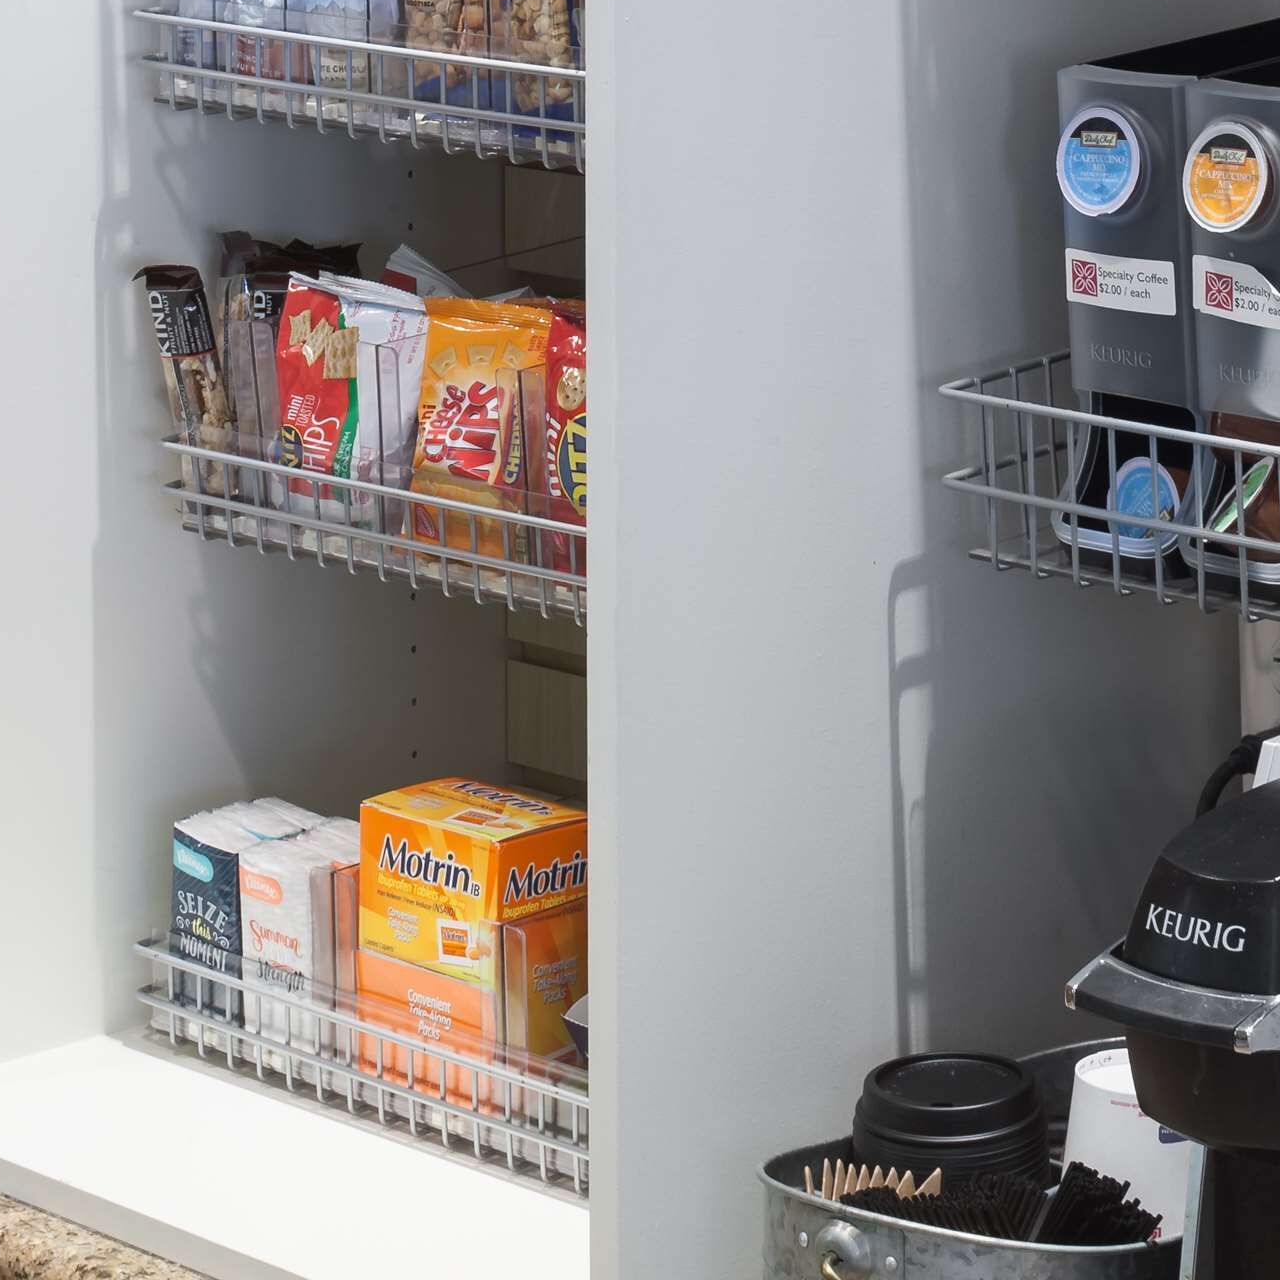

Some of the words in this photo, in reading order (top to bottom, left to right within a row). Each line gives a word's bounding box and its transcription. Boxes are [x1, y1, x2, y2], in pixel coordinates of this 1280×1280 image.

[1098, 267, 1134, 286] Specialty
[1136, 271, 1168, 285] Coffee
[1098, 282, 1121, 296] $2.00
[1130, 287, 1151, 299] each
[1234, 281, 1271, 302] Specialty
[162, 294, 171, 314] NUT
[1234, 297, 1260, 312] $2.00
[149, 291, 171, 357] KIND
[168, 327, 177, 354] FRUIT
[1090, 343, 1153, 369] KEURIG
[287, 394, 305, 420] mini
[295, 394, 315, 427] TOASTED
[302, 414, 340, 472] HIPS
[546, 411, 562, 497] mini
[380, 835, 471, 892] Motrin
[470, 882, 481, 897] IB
[377, 872, 413, 893] Ibuprofen
[413, 884, 438, 901] Tablets
[178, 890, 229, 933] SEIZE
[503, 903, 538, 919] Ibuprofen
[540, 895, 566, 911] Tablets
[192, 917, 212, 941] this
[250, 920, 304, 959] Summon
[1145, 903, 1246, 952] KEURIG
[179, 932, 230, 972] MOMENT
[533, 956, 577, 978] Convenient
[407, 988, 452, 1014] Convenient
[544, 987, 567, 1005] Packs
[408, 1003, 452, 1031] Take-Along
[417, 1020, 441, 1041] Packs
